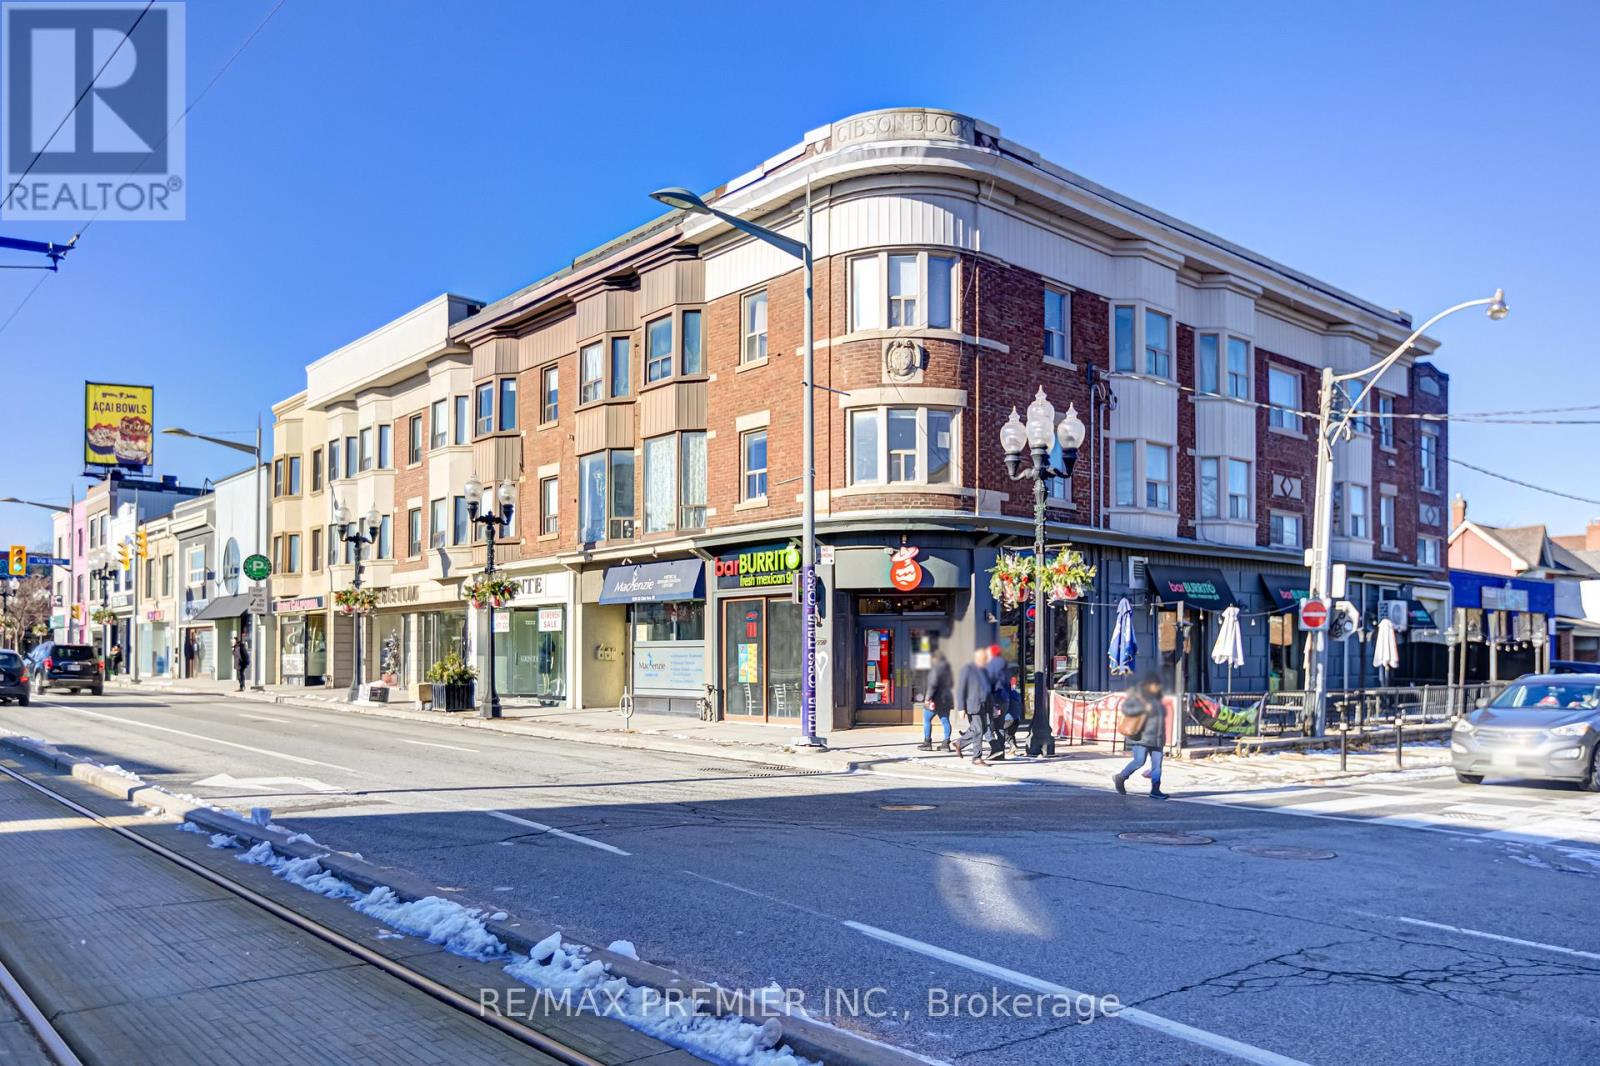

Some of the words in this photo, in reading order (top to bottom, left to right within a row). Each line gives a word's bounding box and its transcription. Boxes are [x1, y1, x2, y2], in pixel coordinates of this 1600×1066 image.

[836, 115, 905, 143] GIBSON
[912, 114, 970, 138] BLOCK
[116, 403, 147, 414] BOWLS
[252, 560, 264, 572] P
[516, 577, 543, 595] NTE
[740, 574, 755, 587] fresh
[756, 572, 785, 586] mexican
[1168, 580, 1217, 594] barBURRITO
[544, 620, 558, 628] SALE
